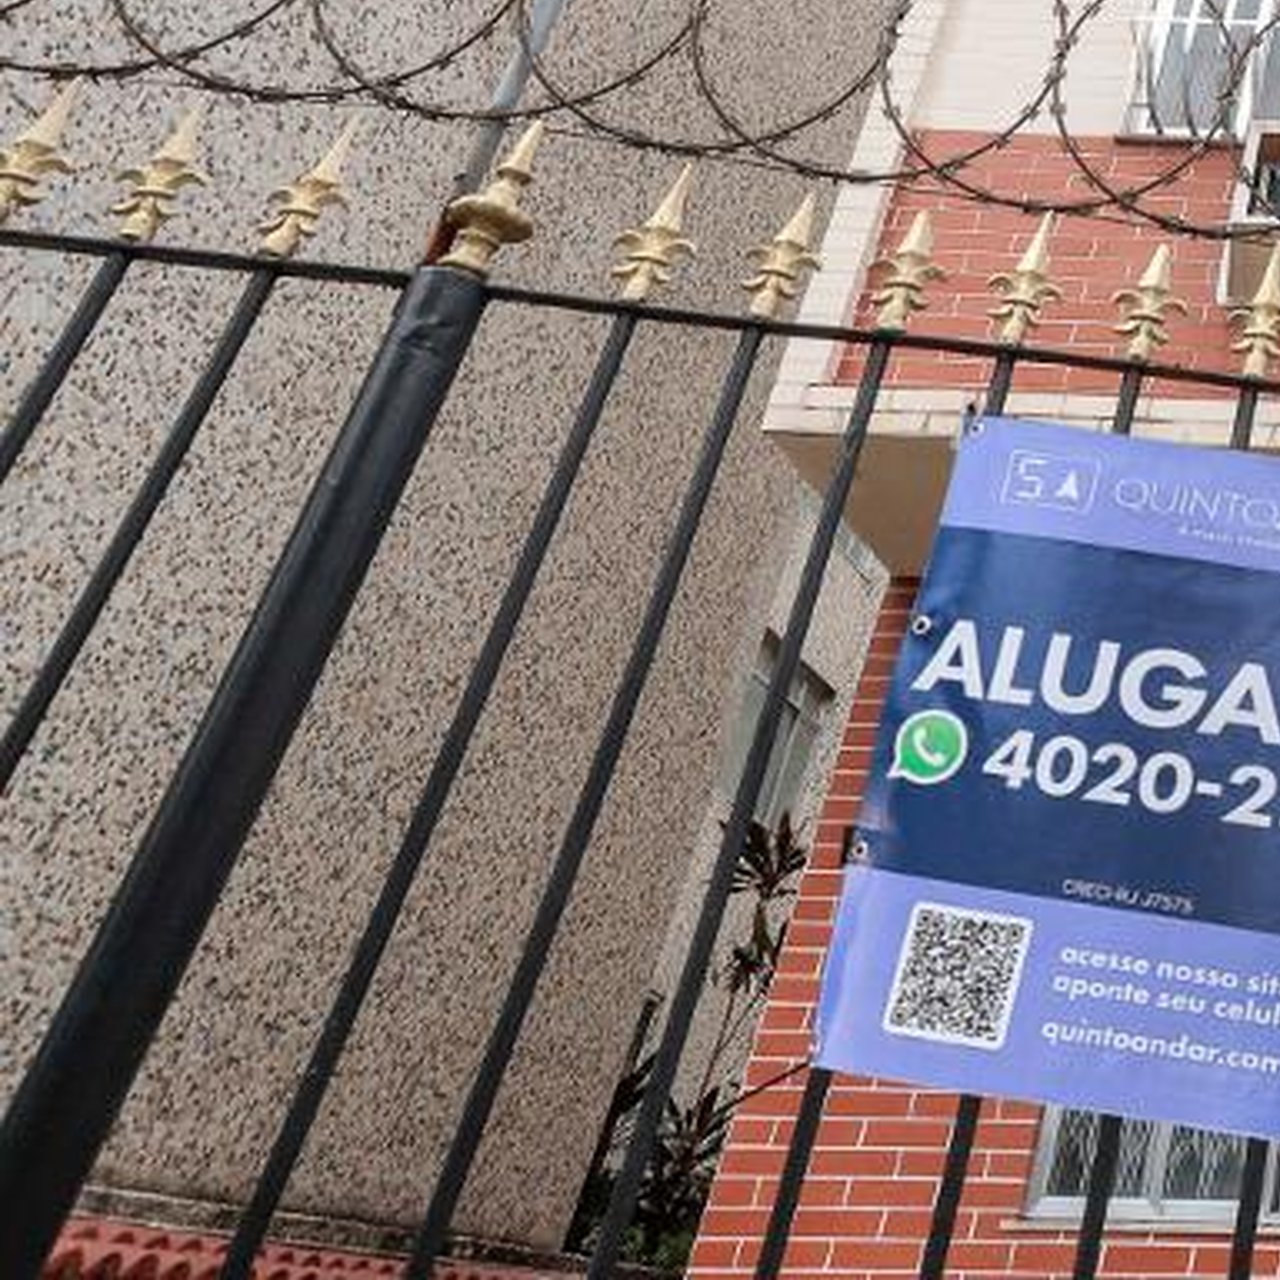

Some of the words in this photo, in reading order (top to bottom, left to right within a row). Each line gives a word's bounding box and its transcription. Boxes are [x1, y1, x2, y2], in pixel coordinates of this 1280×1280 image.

[1060, 946, 1150, 975] acesse
[1156, 959, 1239, 989] nosso
[1053, 974, 1150, 1002] aponte
[1155, 992, 1206, 1015] seu
